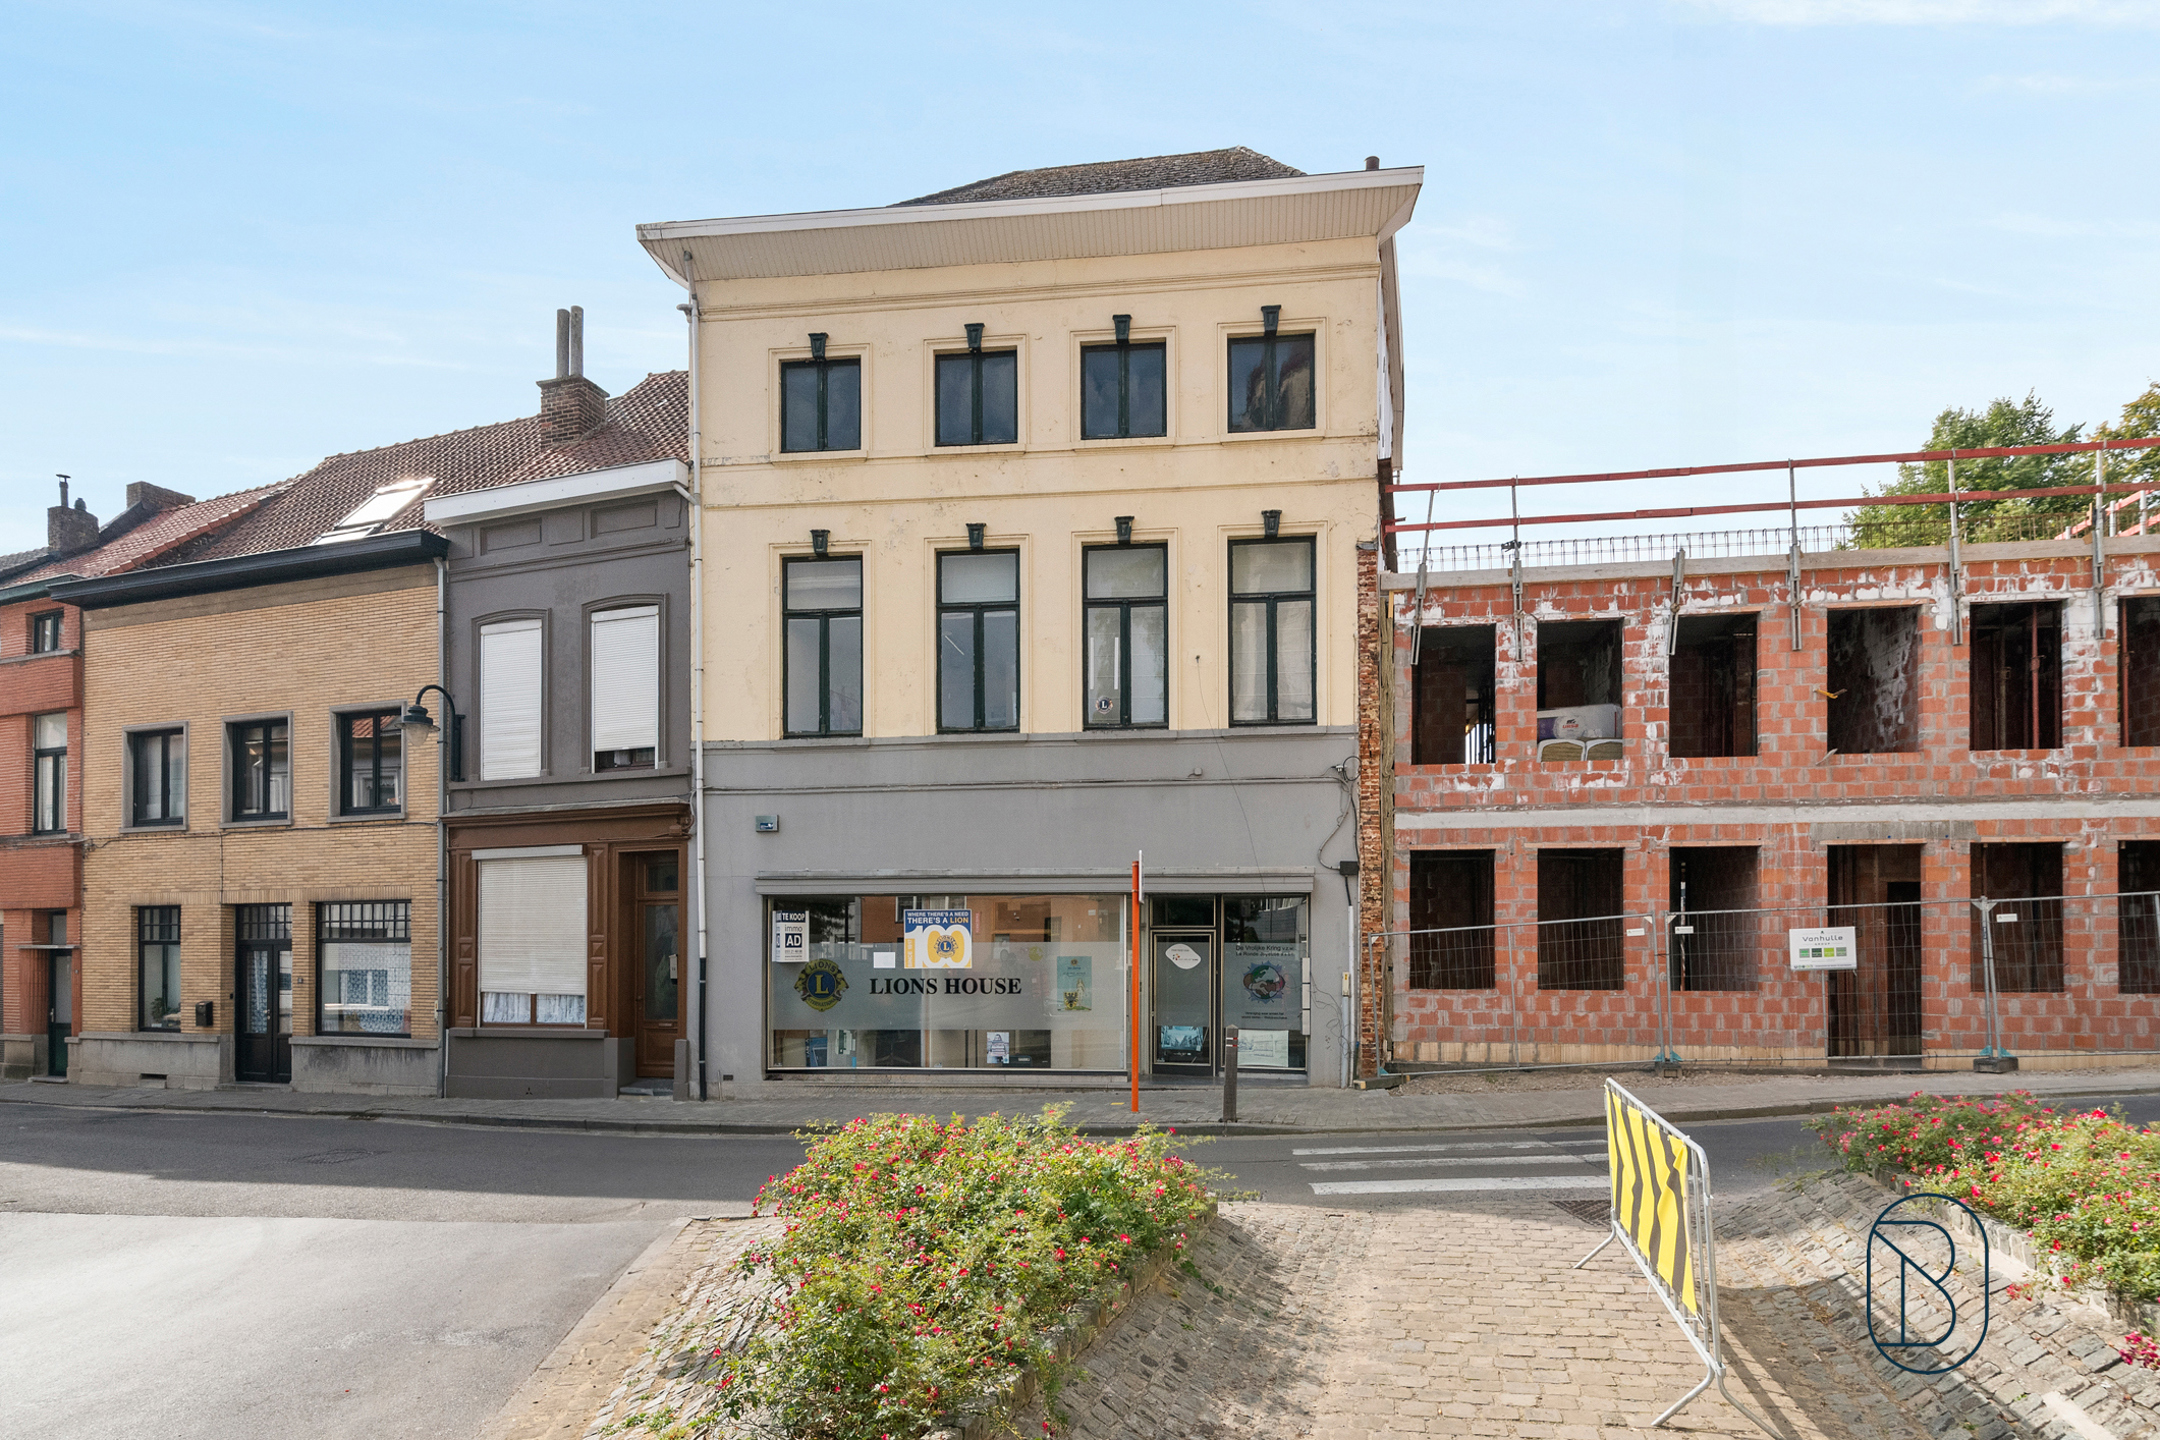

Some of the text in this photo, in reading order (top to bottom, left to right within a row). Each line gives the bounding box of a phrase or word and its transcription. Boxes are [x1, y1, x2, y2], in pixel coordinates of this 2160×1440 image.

[1101, 700, 1108, 709] L
[782, 912, 789, 921] TE
[789, 912, 806, 921] KOOP
[784, 924, 803, 932] immo
[786, 934, 802, 946] AD
[905, 924, 971, 968] 100
[943, 942, 950, 951] L
[809, 961, 837, 973] LIONS
[814, 974, 829, 994] L
[869, 977, 1022, 995] LIONS HOUSE
